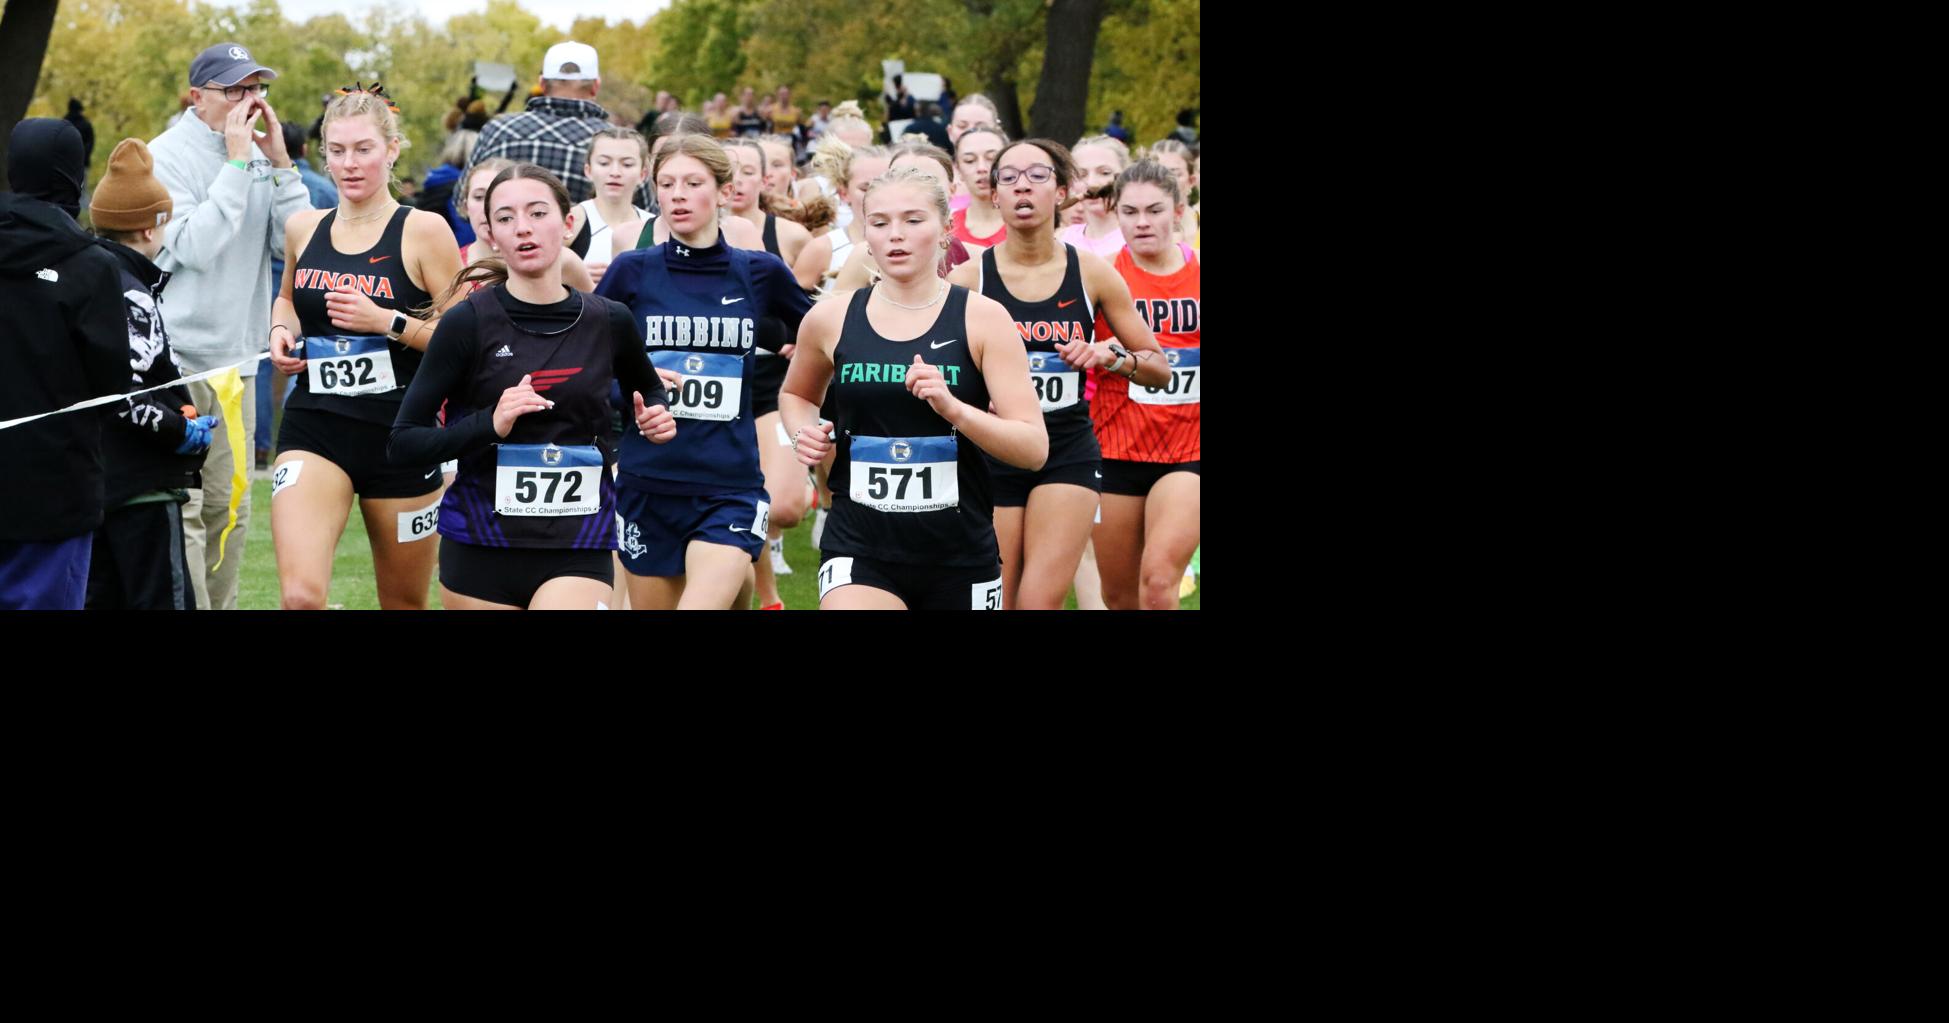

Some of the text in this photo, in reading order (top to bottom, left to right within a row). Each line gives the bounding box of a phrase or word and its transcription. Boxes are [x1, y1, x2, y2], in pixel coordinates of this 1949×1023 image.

[294, 268, 394, 299] WINONA
[1134, 298, 1200, 334] APID
[645, 315, 754, 349] HIBBING
[319, 357, 377, 390] 632
[840, 362, 961, 386] FARIBLT
[1144, 370, 1196, 395] 07
[515, 471, 583, 503] 572
[868, 467, 932, 500] 571
[538, 506, 592, 515] Championships
[877, 503, 889, 511] CC
[890, 503, 949, 511] Championships
